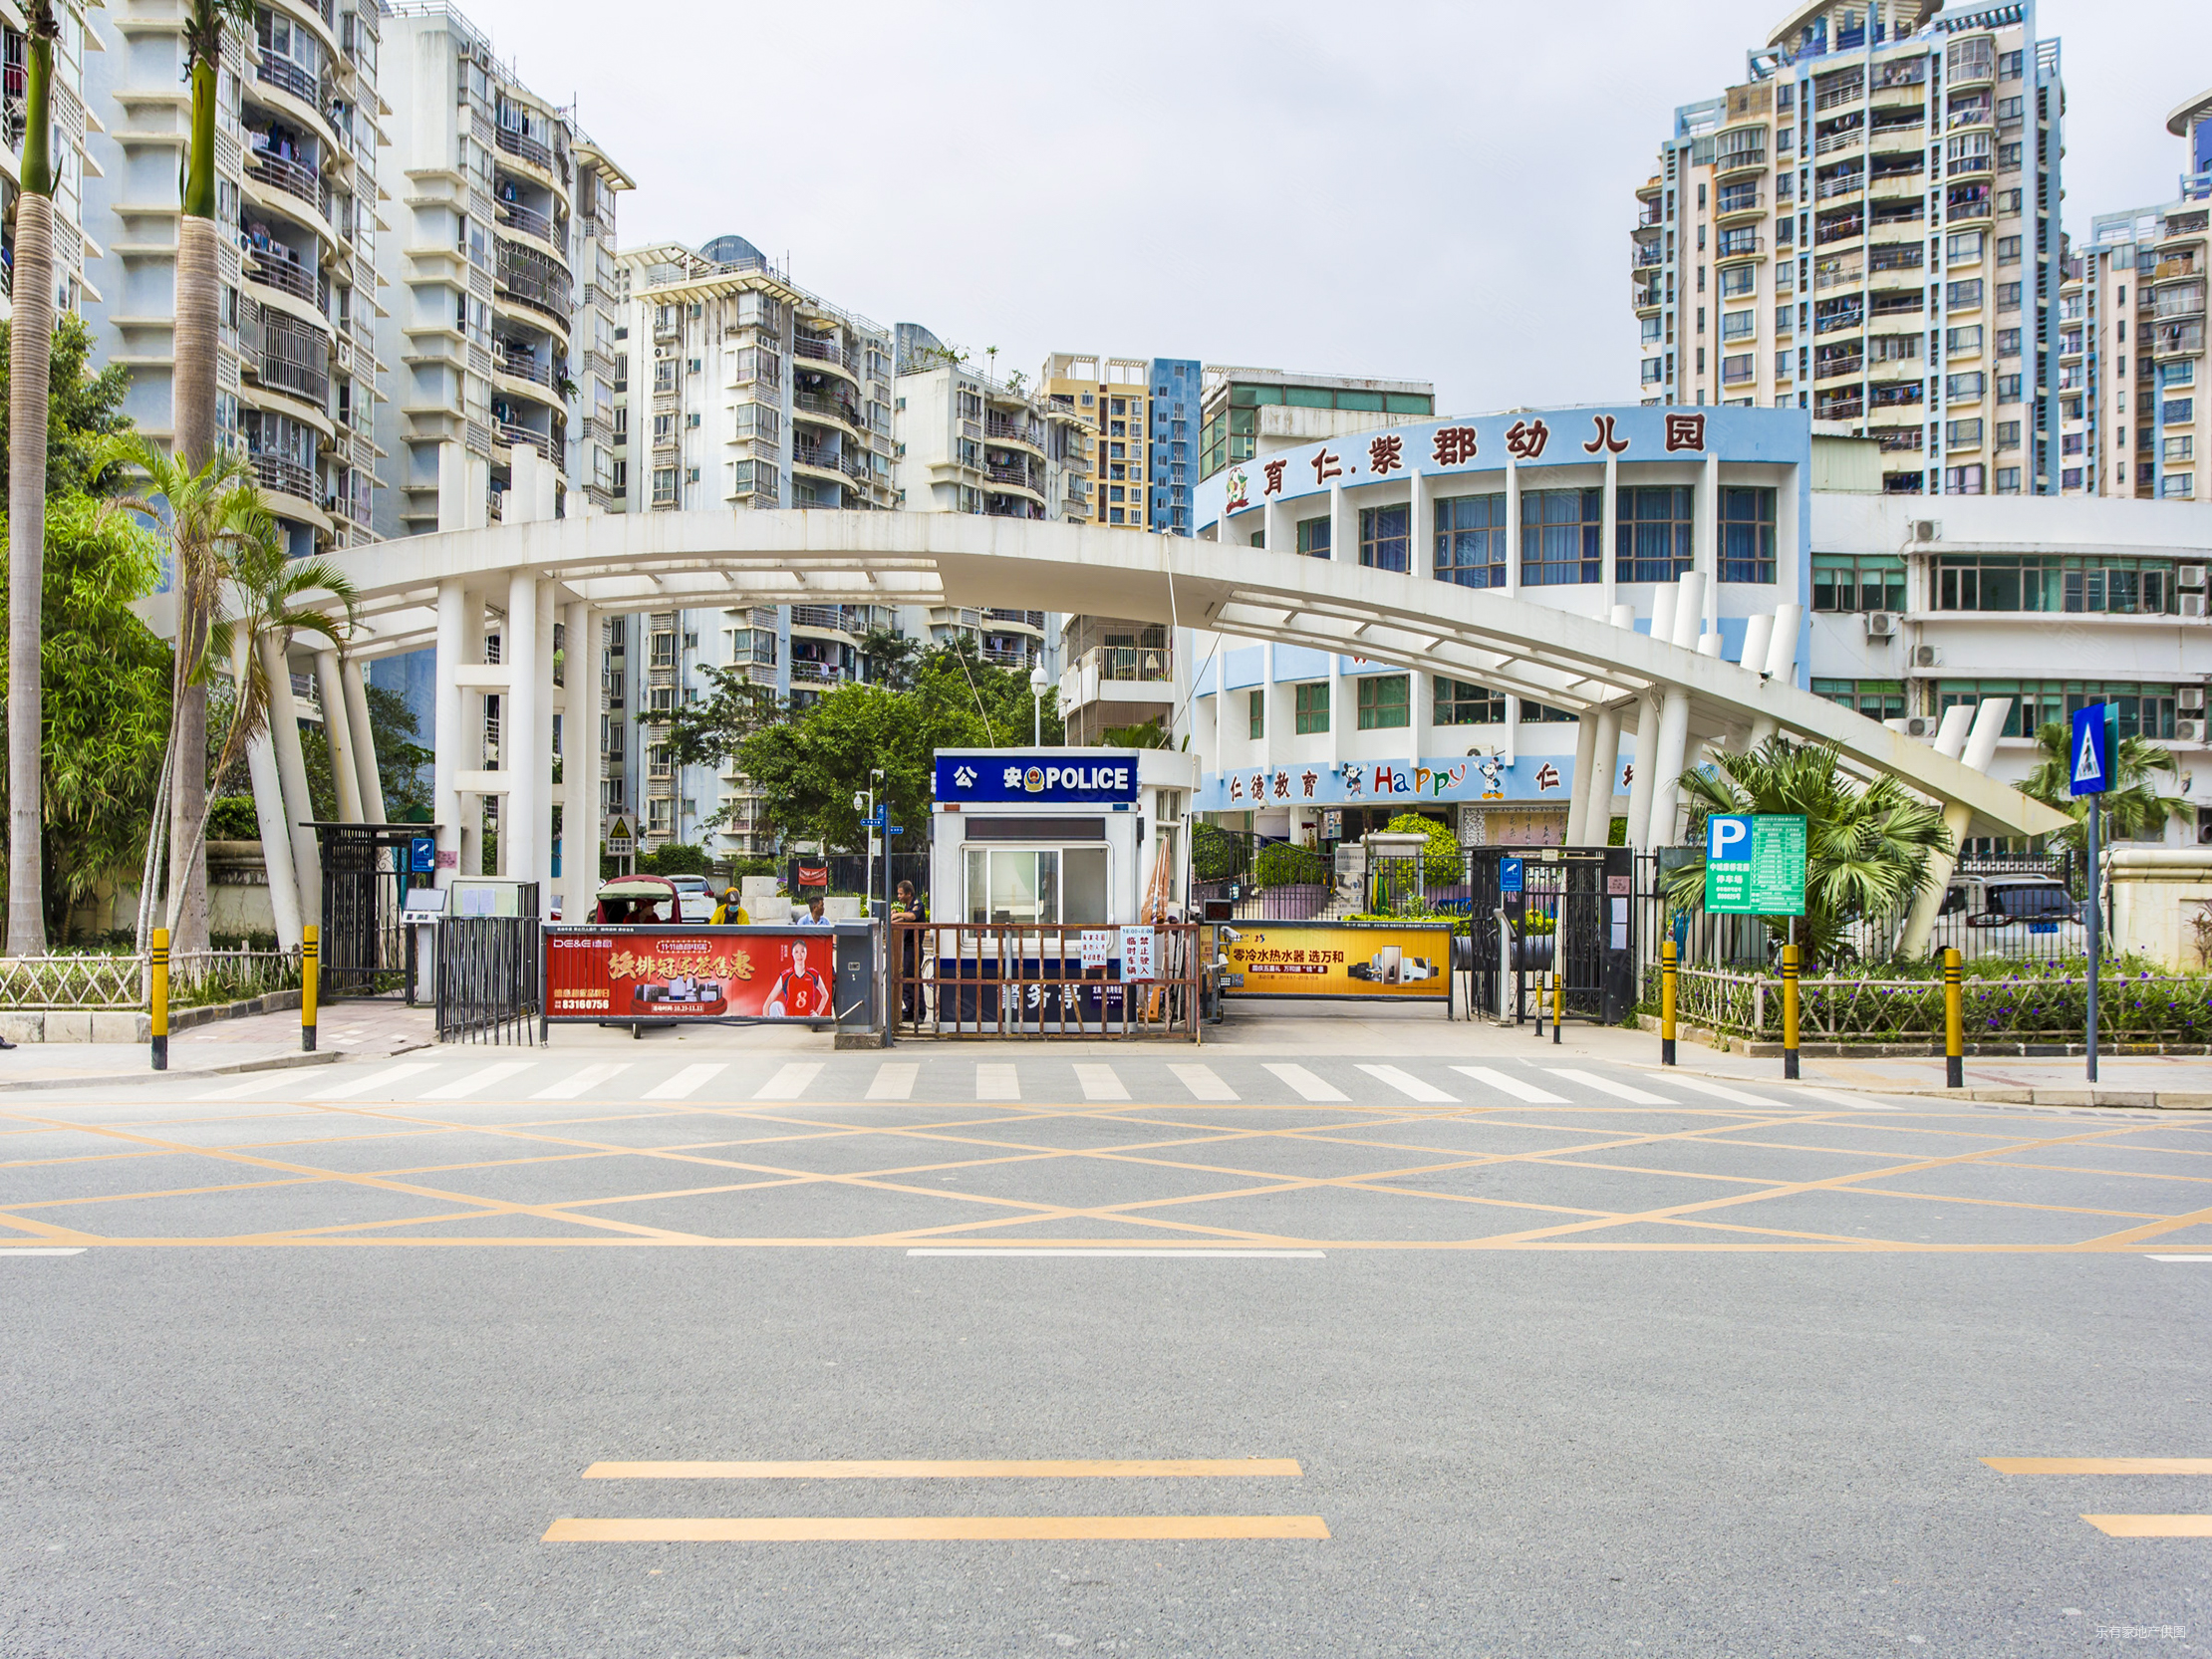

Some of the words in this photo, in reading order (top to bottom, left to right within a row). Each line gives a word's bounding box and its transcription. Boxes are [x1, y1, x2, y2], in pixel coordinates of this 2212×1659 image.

[1046, 767, 1129, 790] POLICE
[1230, 768, 1318, 802] 仁德教育
[1374, 762, 1466, 797] Happy
[1712, 819, 1747, 859] P
[1126, 937, 1137, 974] 临时车辆
[1139, 937, 1150, 974] 禁止驶入
[1234, 949, 1305, 964] 零冷水热水器
[1308, 950, 1344, 964] 选万和
[562, 999, 609, 1009] 83160756
[795, 990, 807, 1008] 8
